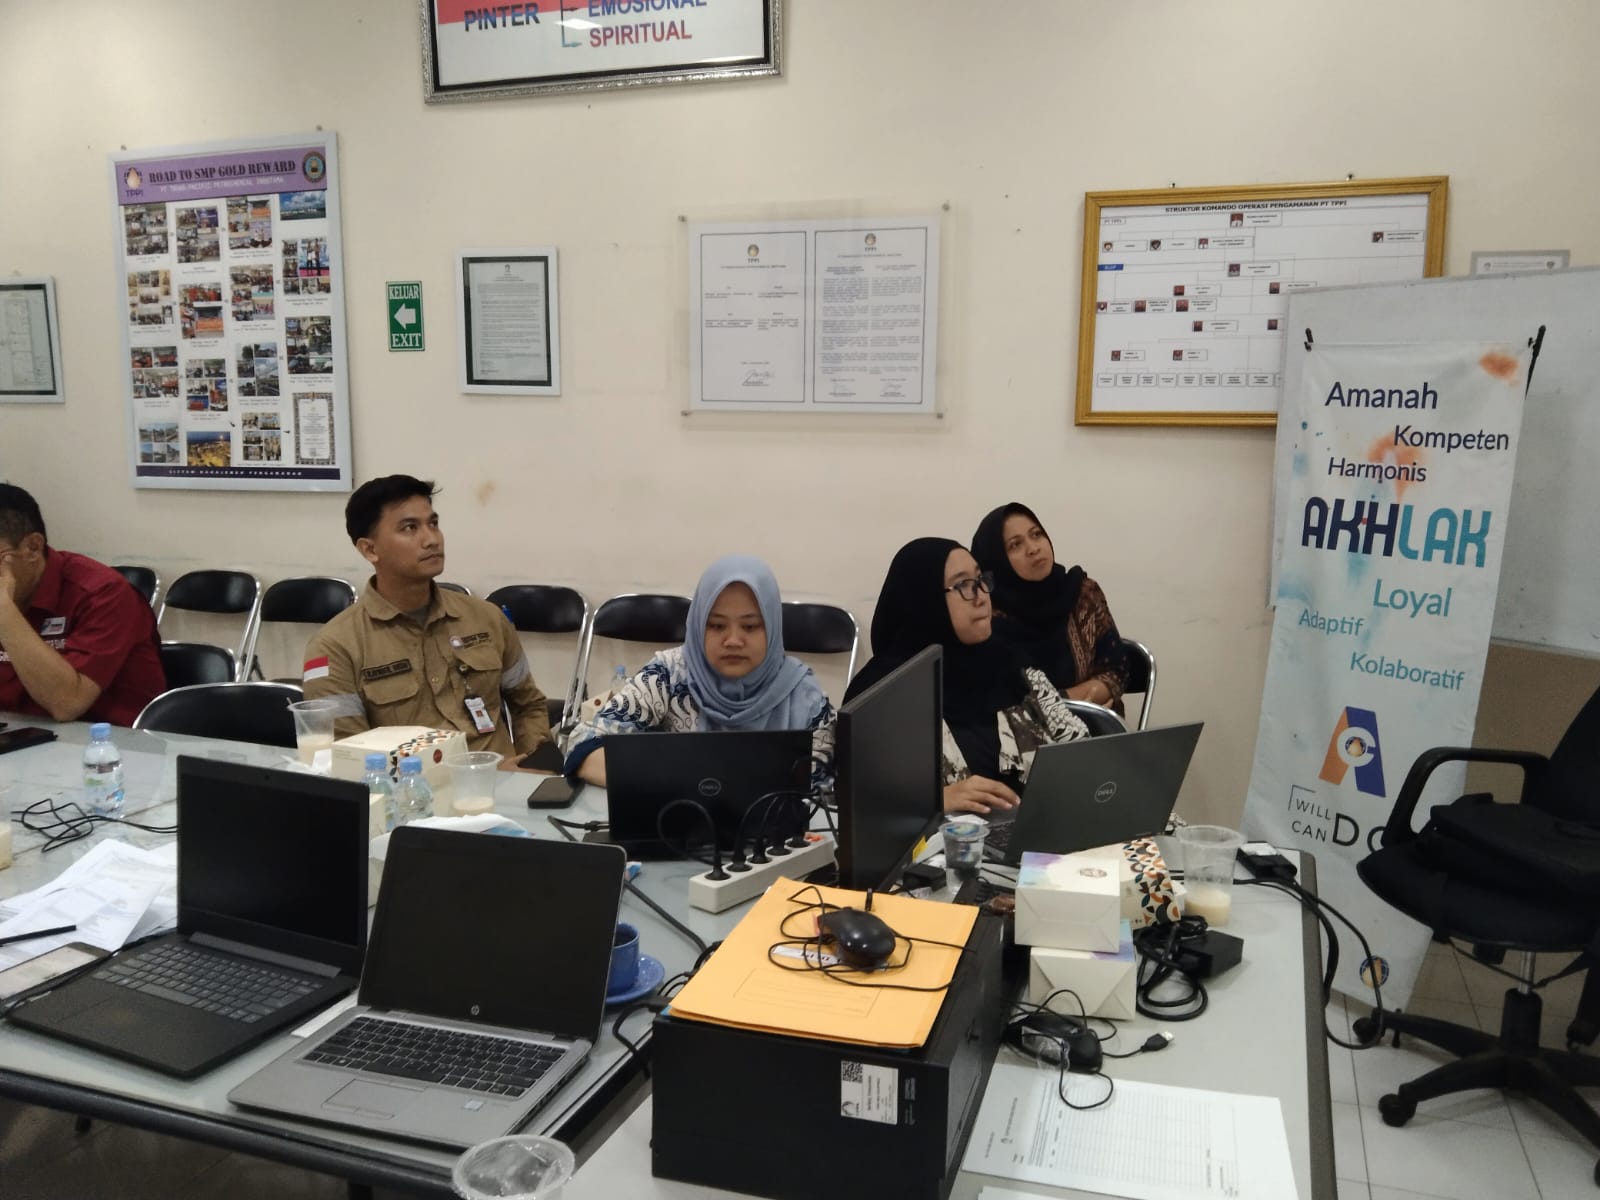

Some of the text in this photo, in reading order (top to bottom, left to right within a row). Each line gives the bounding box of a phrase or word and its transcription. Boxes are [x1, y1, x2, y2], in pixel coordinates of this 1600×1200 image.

[464, 2, 541, 32] PINTER
[589, 20, 693, 48] SPIRITUAL
[149, 160, 296, 183] ROAD TO SMP GOLD REWARD
[1270, 201, 1319, 209] PENGAMANAN
[389, 285, 419, 300] KELUAR
[391, 333, 421, 347] EXIT
[1325, 381, 1438, 410] Amanah
[1393, 425, 1510, 454] Kompeten
[1328, 457, 1428, 482] Harmonis
[1302, 496, 1492, 568] AKHLAK
[1373, 579, 1453, 618] Loyal
[1298, 609, 1364, 636] Adaptif
[1350, 651, 1465, 691] Kolaboratif
[1296, 798, 1331, 820] WILL
[1291, 820, 1327, 843] CAN
